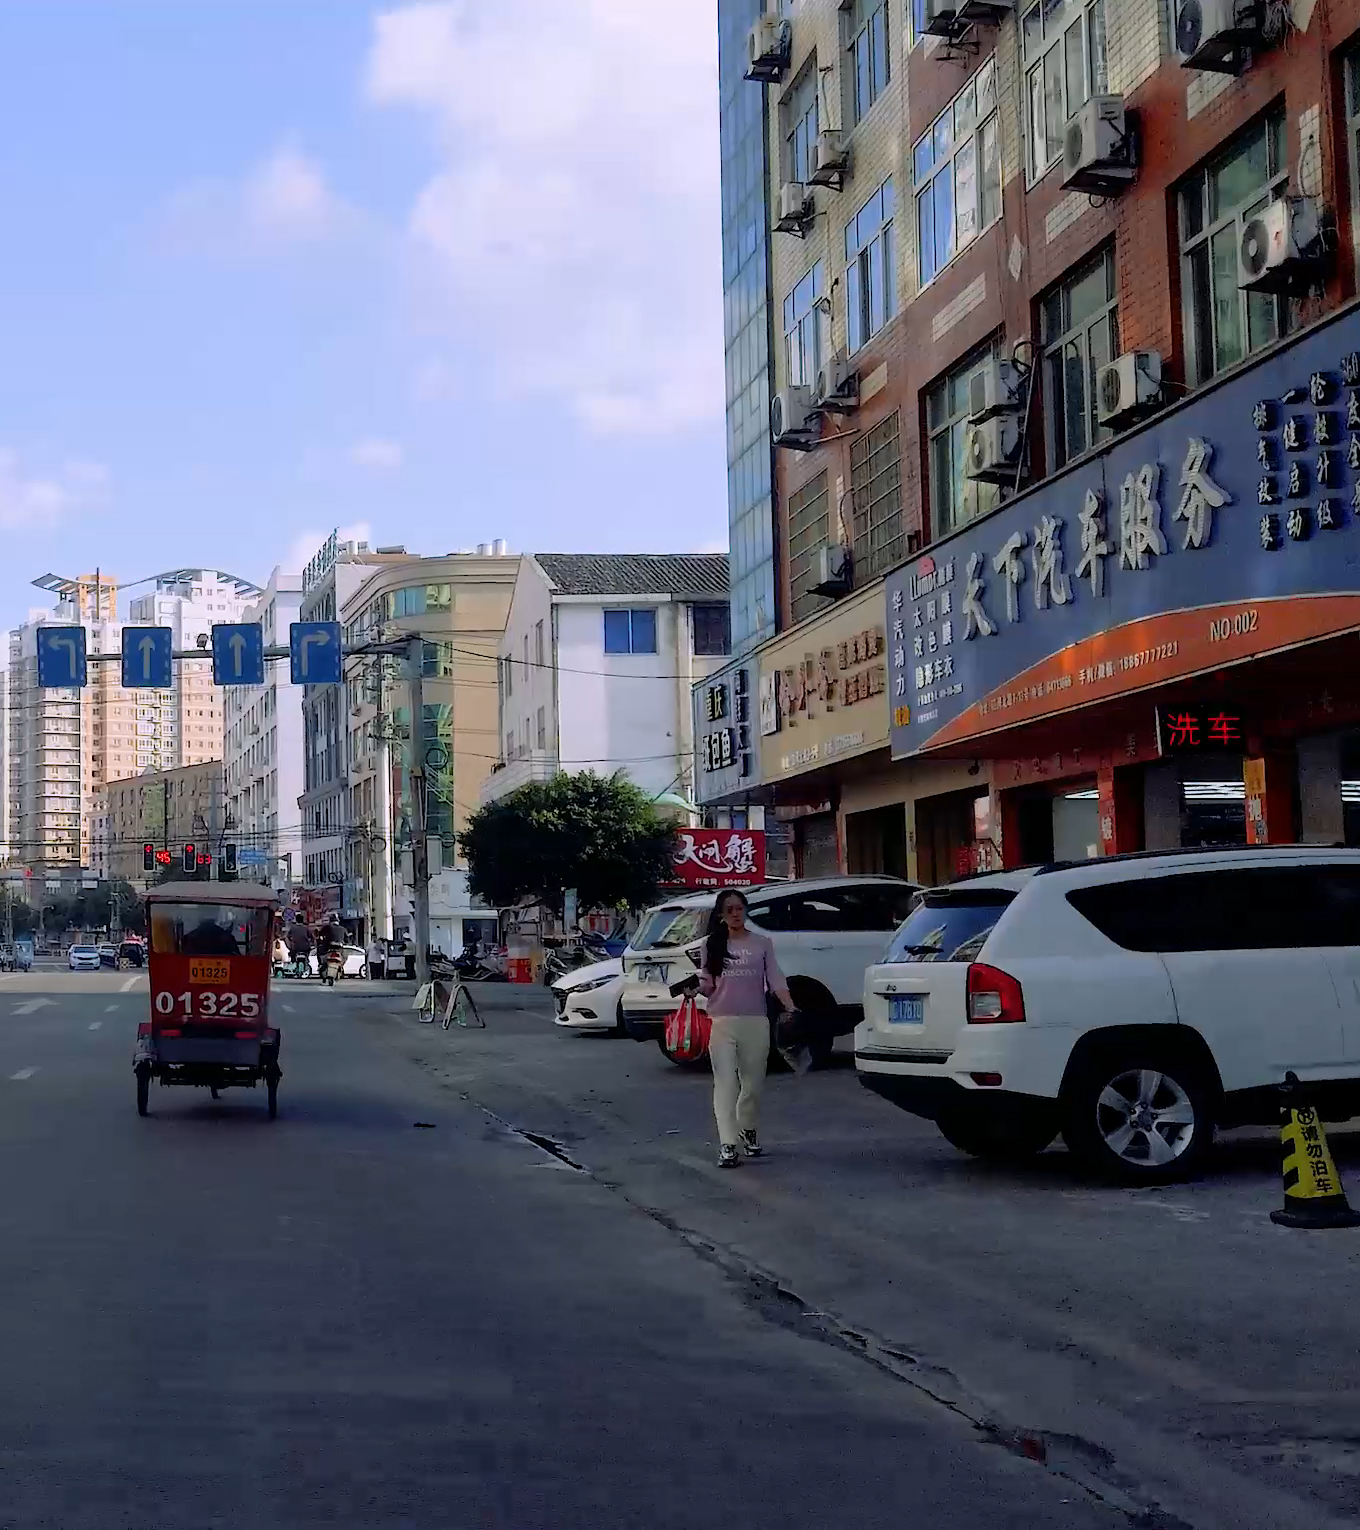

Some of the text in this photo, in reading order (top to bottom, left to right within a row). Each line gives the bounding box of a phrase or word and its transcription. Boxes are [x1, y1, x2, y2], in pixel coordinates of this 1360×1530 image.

[962, 436, 1234, 642] 天下汽车服务
[1166, 712, 1241, 746] 洗车
[191, 967, 228, 979] 01325
[155, 990, 261, 1018] 01325
[1300, 1125, 1334, 1194] 请勿泊车
